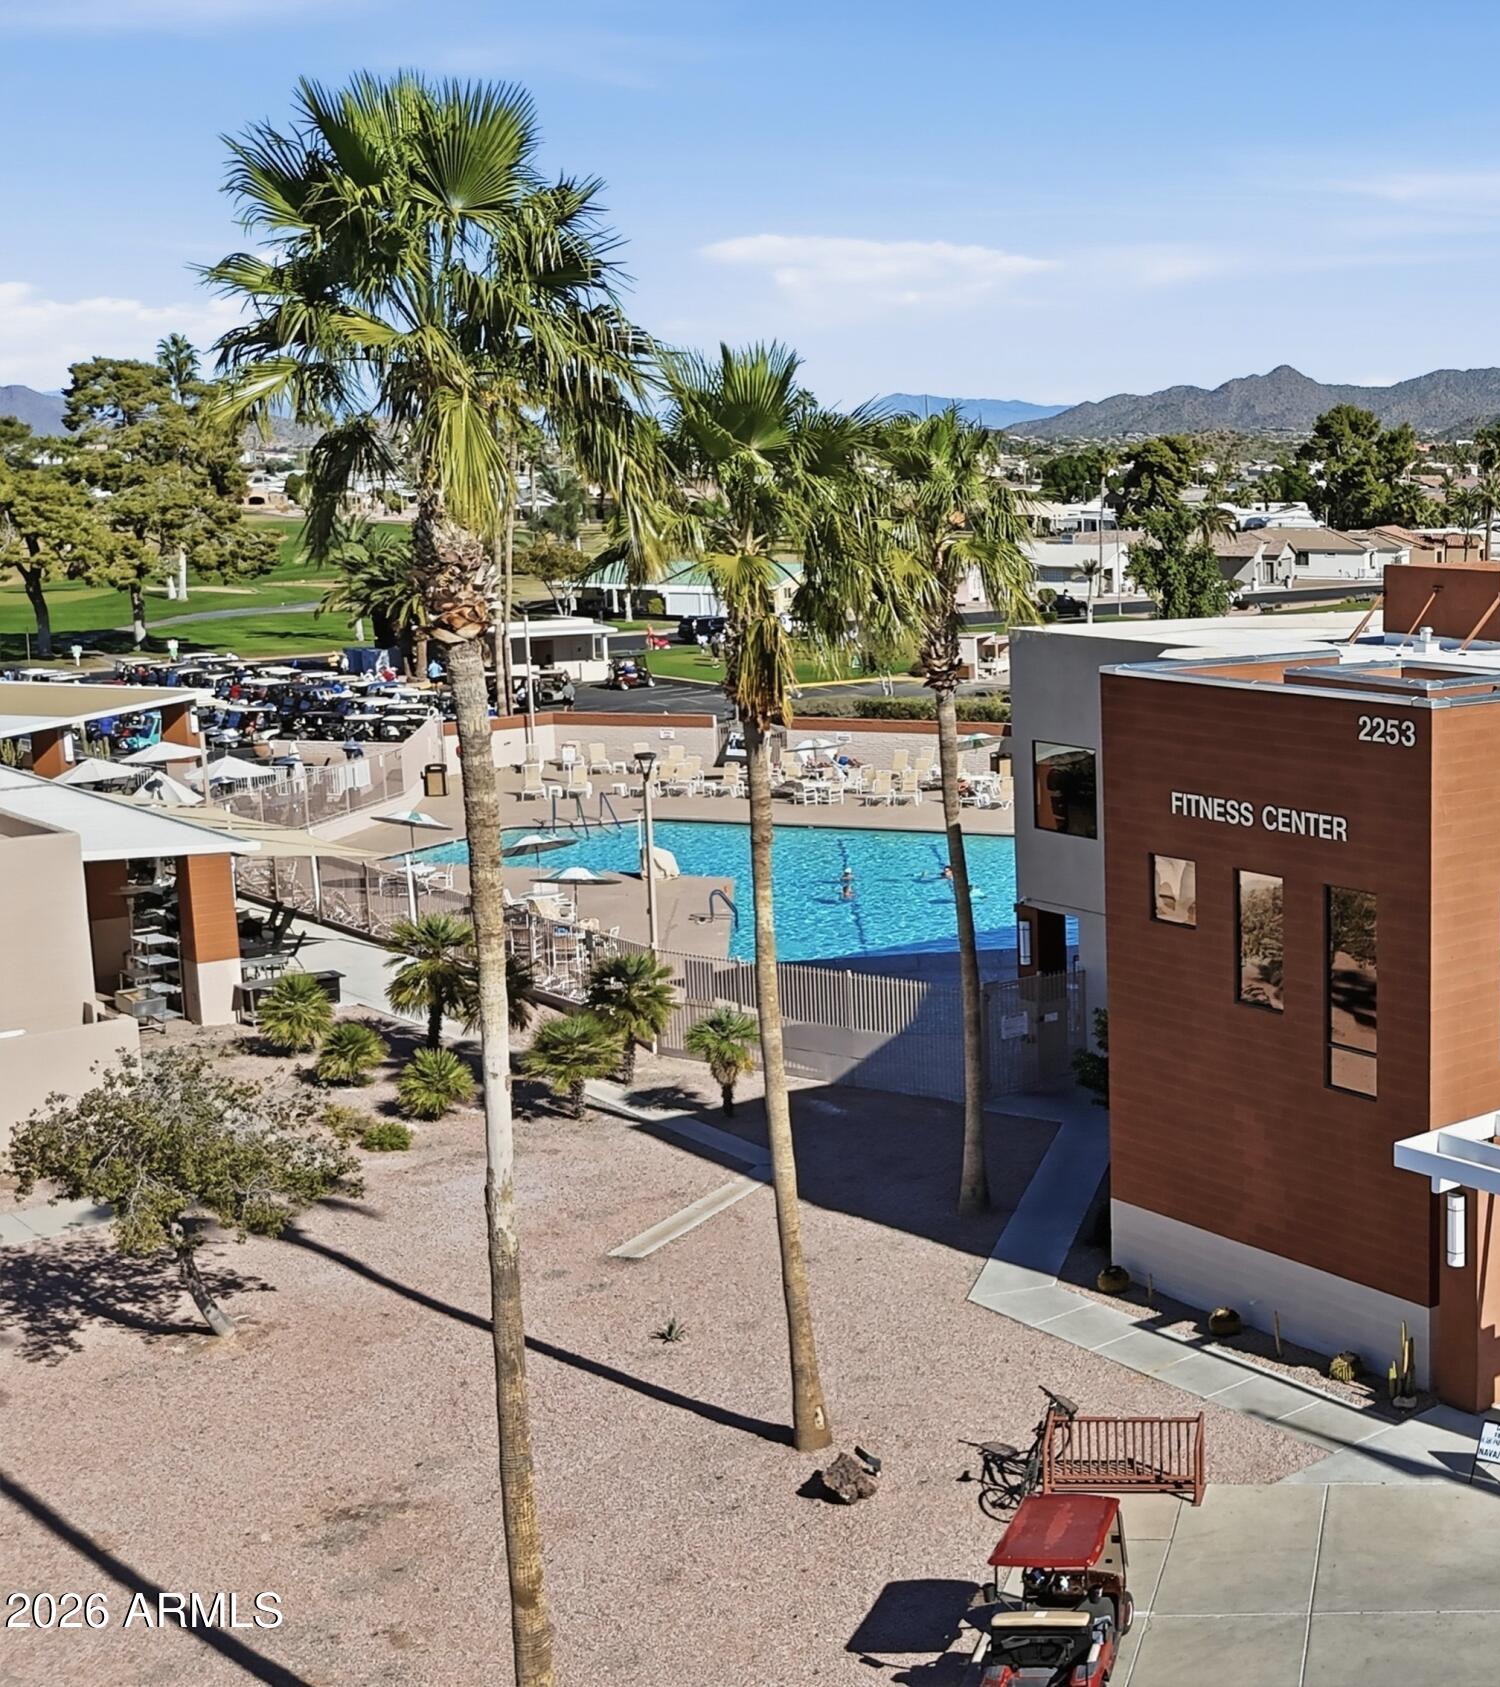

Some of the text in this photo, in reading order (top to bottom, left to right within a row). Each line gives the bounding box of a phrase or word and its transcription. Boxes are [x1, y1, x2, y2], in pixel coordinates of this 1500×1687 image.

[1358, 716, 1416, 747] 2253
[1171, 791, 1348, 842] FITNESS CENTER
